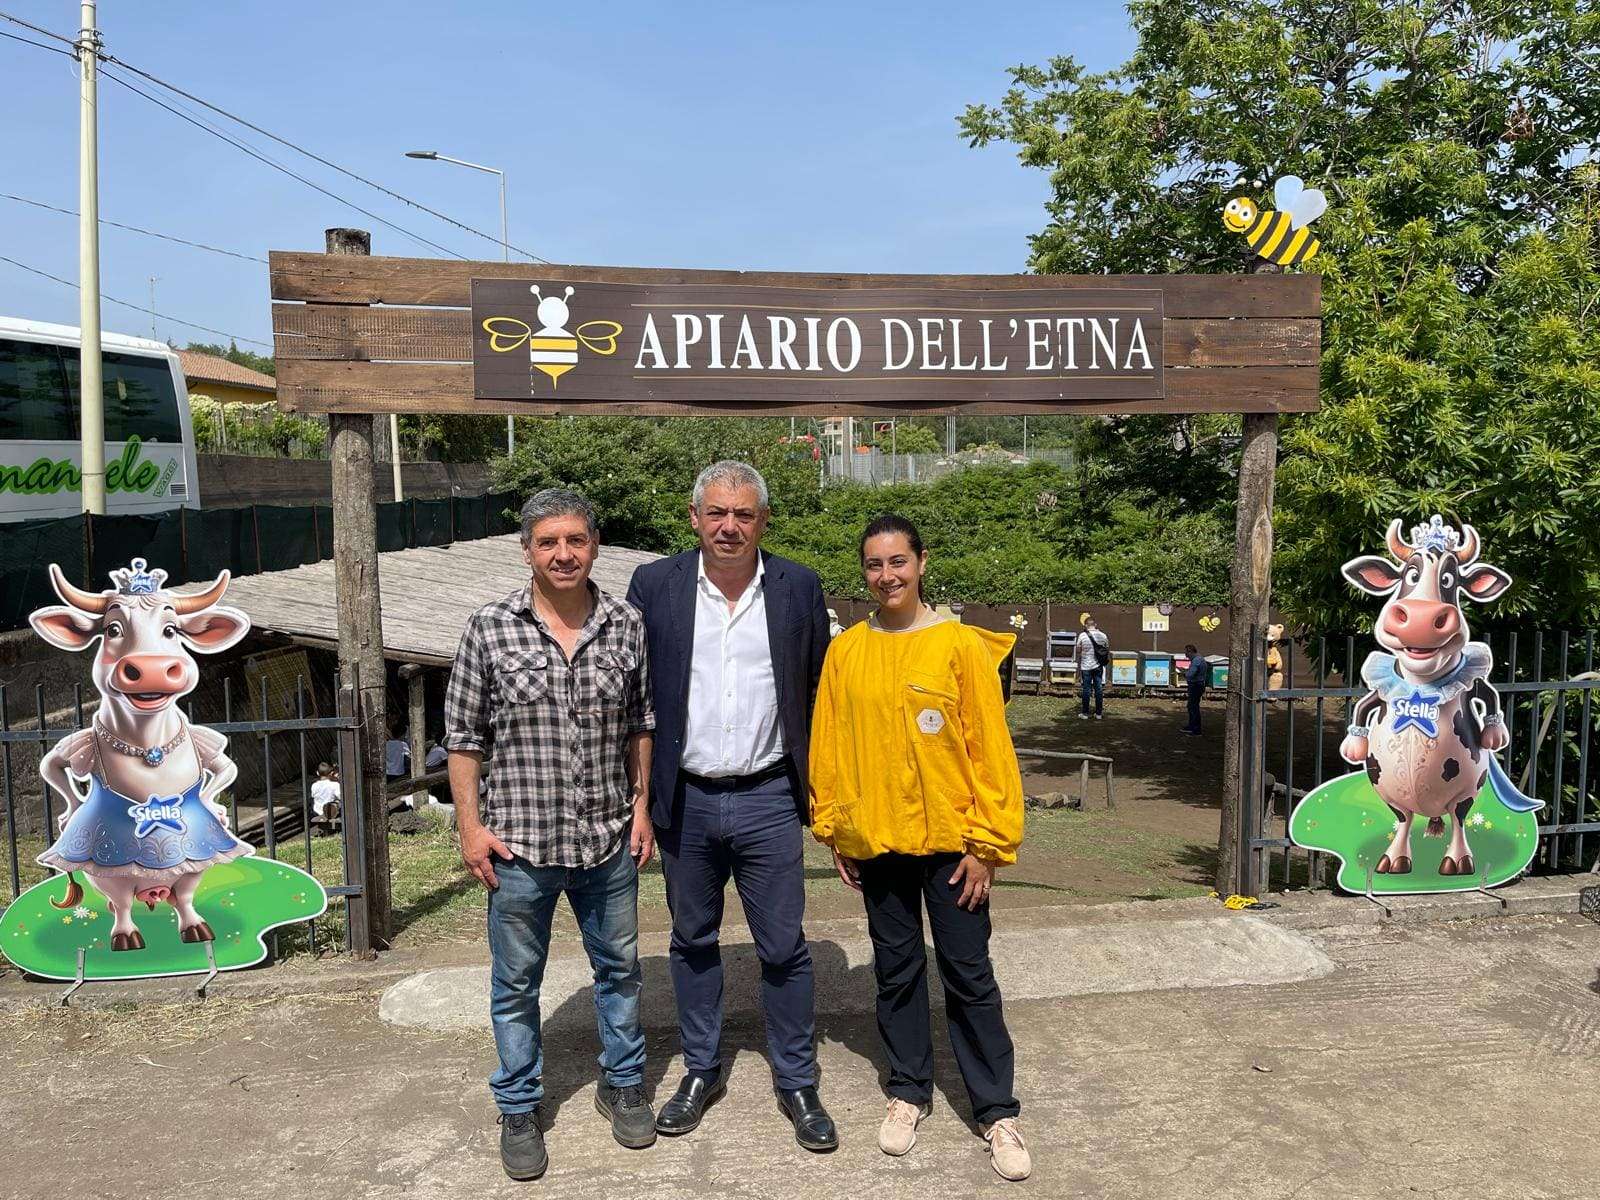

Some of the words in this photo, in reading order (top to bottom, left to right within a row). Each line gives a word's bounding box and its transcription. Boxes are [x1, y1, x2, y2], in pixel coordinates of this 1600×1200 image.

[634, 313, 862, 373] APIARIO
[880, 317, 1154, 371] DELL'ETNA
[1395, 699, 1438, 720] Stella
[135, 805, 182, 822] Stella
